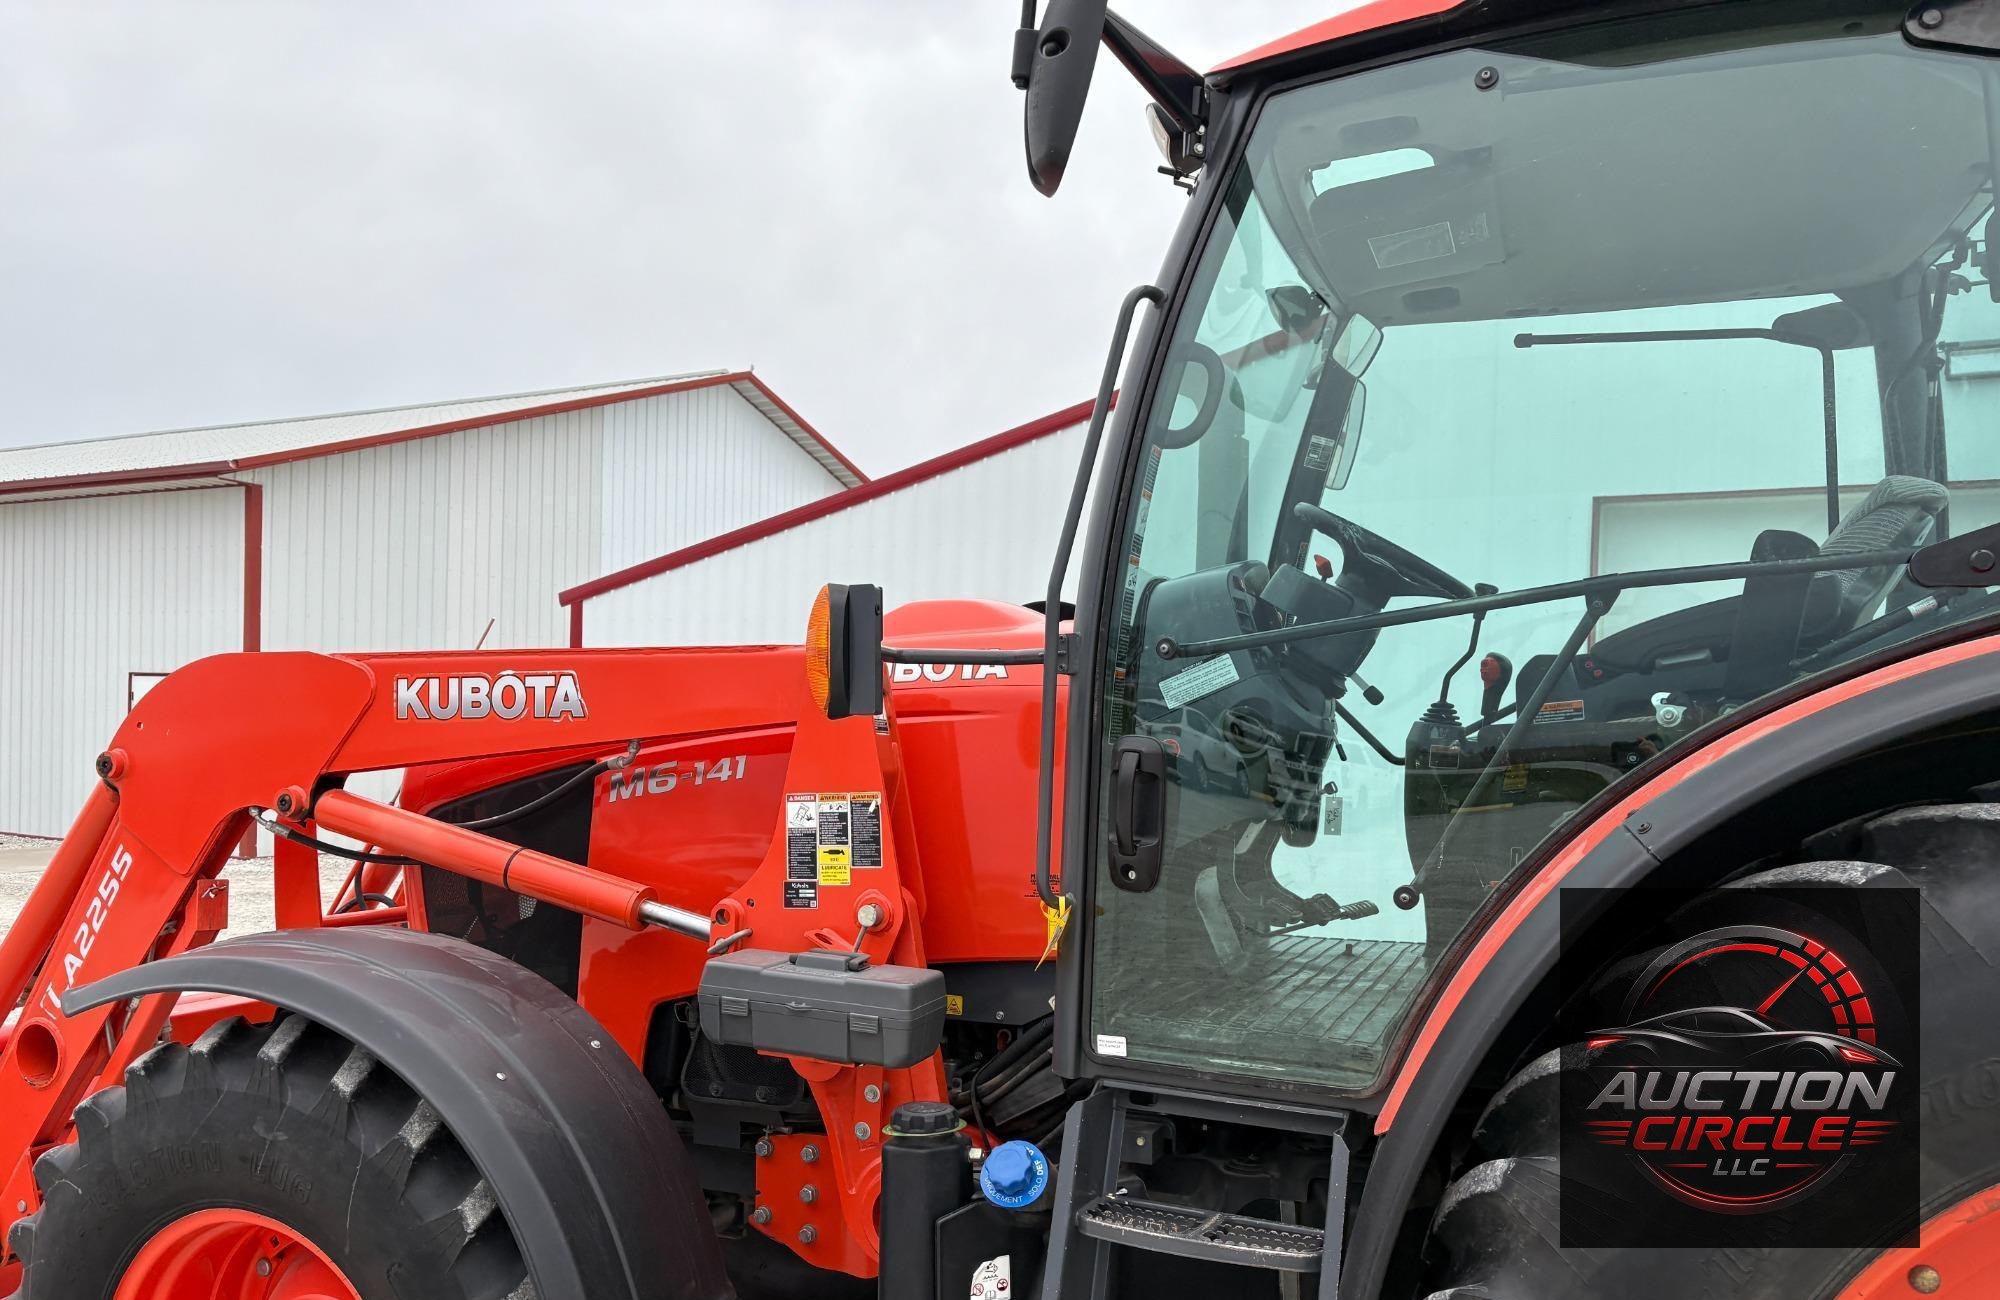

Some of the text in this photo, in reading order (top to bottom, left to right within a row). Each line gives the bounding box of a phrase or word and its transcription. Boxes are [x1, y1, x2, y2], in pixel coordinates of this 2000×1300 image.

[396, 673, 586, 720] KUBOTA
[608, 754, 747, 803] M6-141
[1034, 1159, 1044, 1176] DEF
[1028, 1177, 1043, 1197] SOLO
